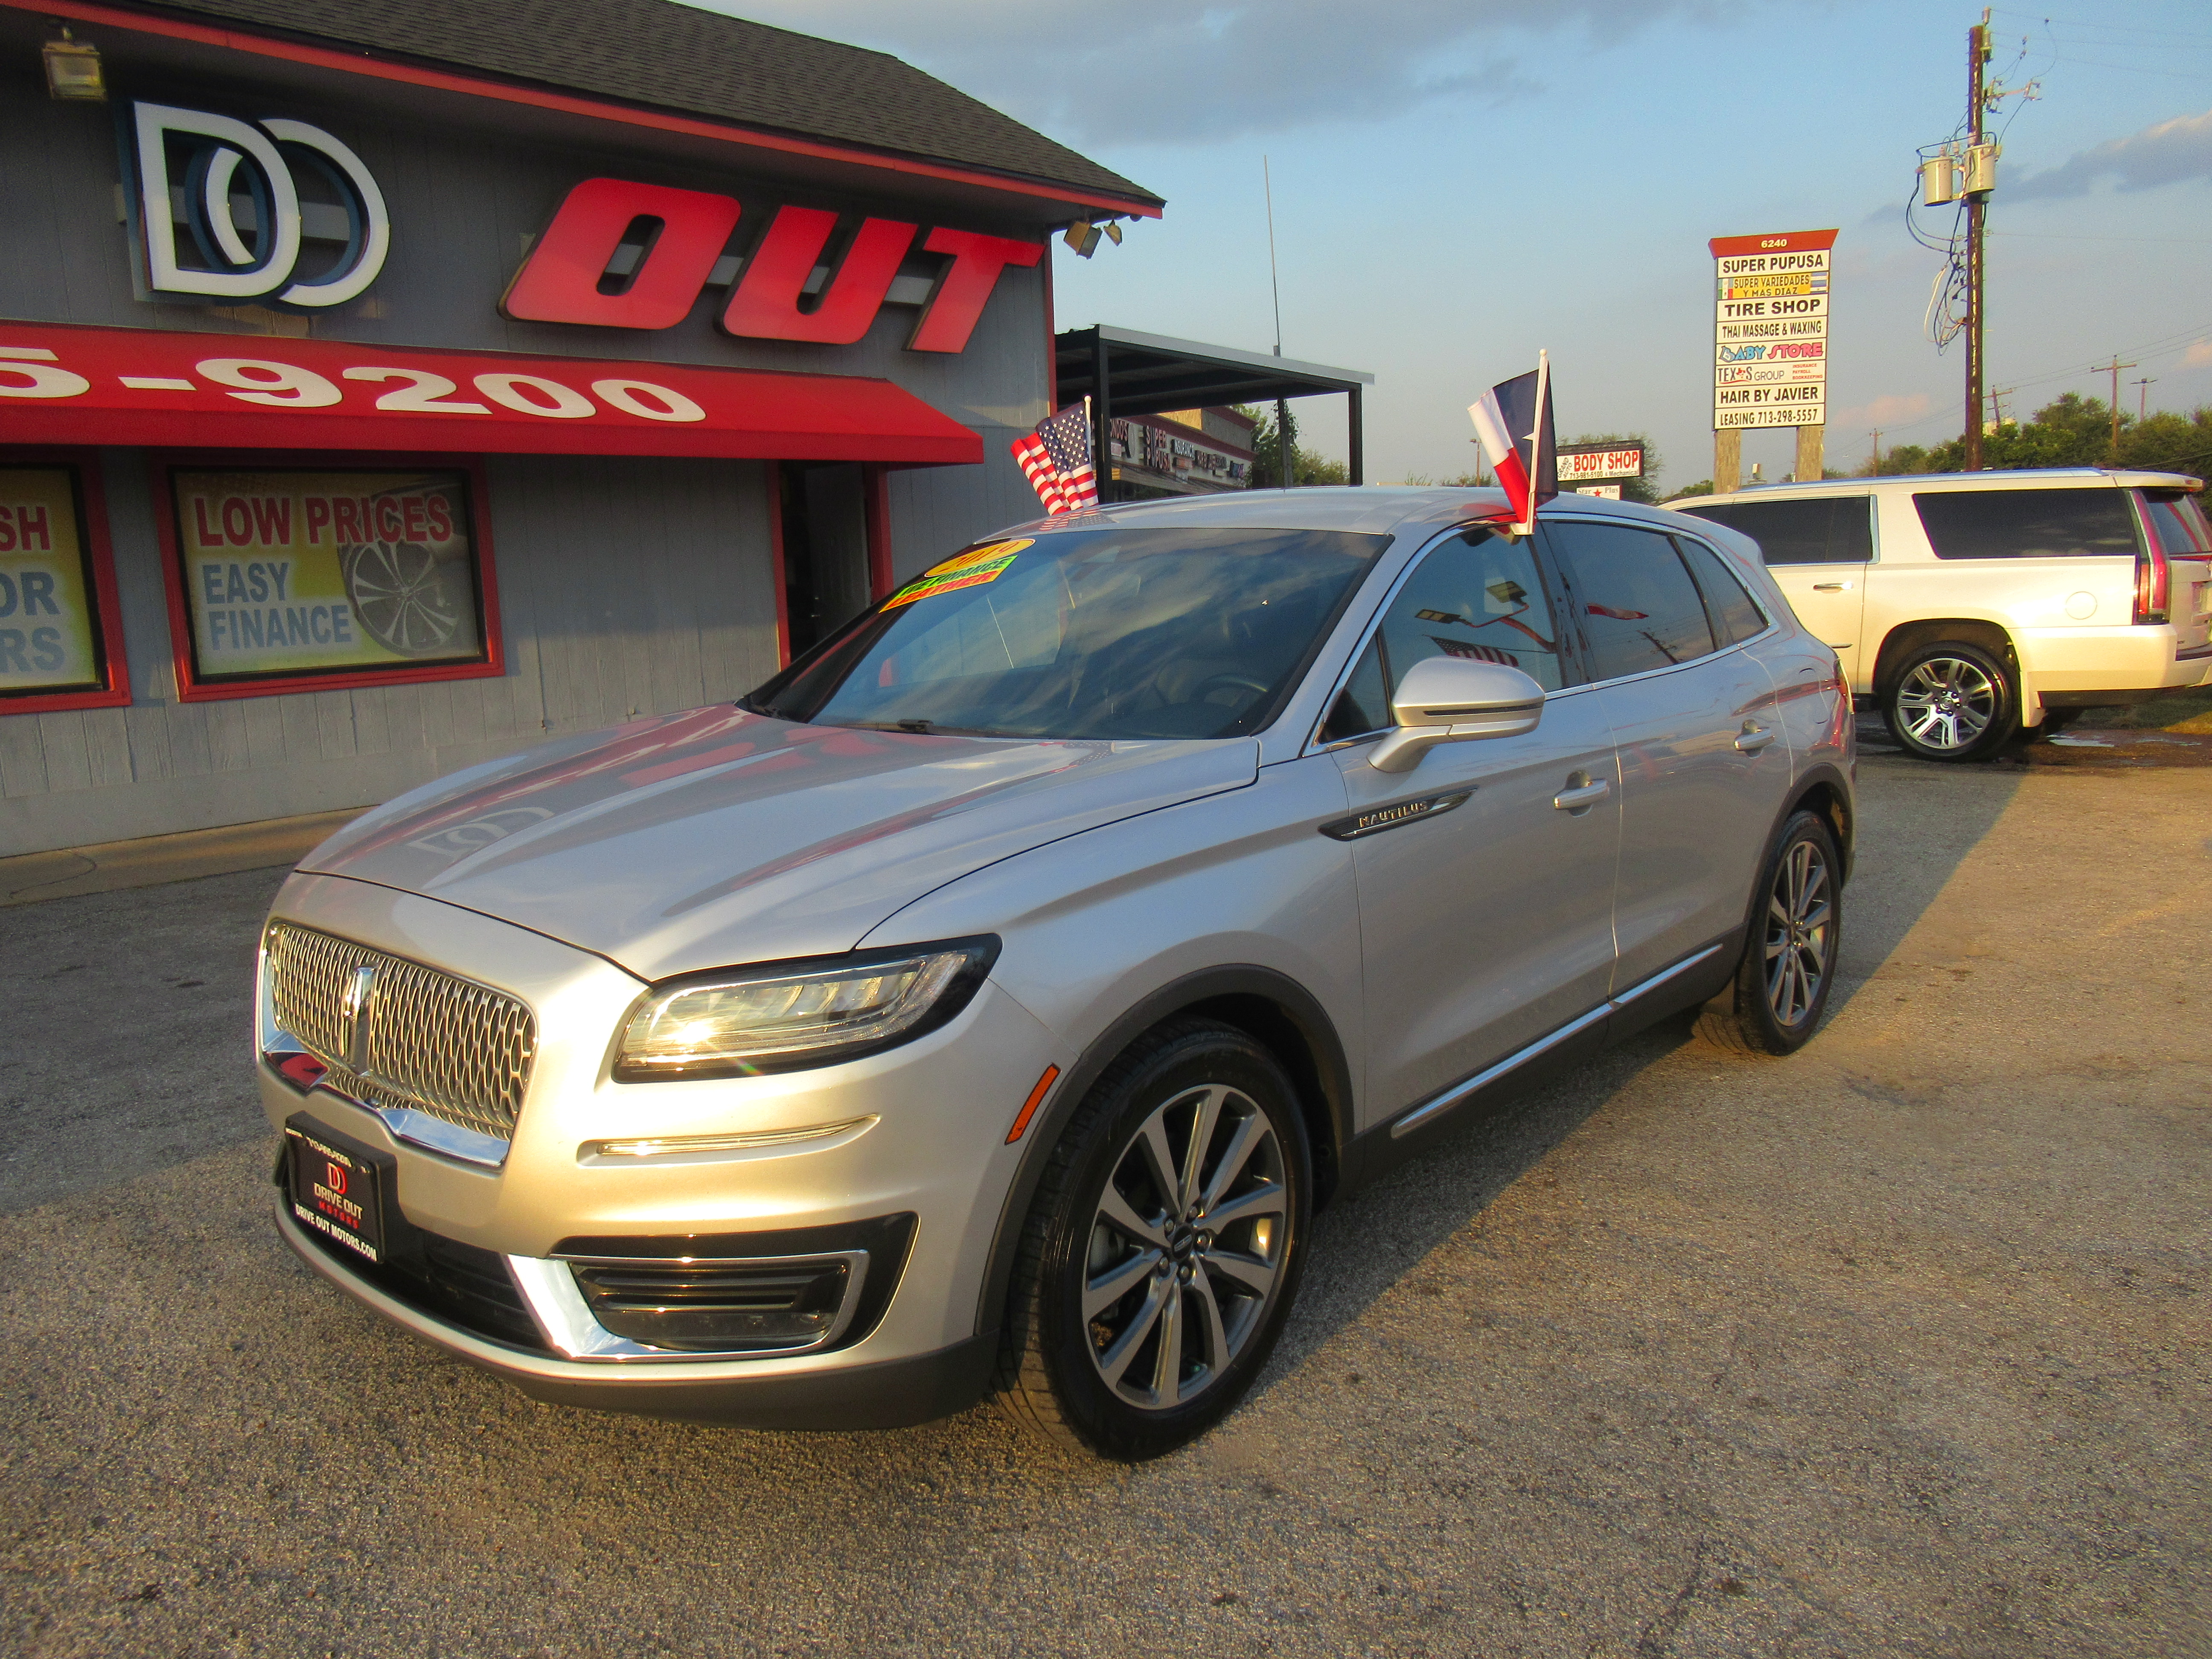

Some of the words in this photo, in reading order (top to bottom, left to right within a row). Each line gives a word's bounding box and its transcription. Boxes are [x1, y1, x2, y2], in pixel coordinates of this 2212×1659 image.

[1761, 239, 1787, 248] 6240
[504, 177, 1046, 353] OUT
[1723, 258, 1766, 274] SUPER
[1770, 254, 1823, 271] PUPUSA
[1734, 278, 1760, 289] SUPER
[1761, 274, 1810, 288] VARIEDADES
[1743, 289, 1749, 297] Y
[1751, 288, 1773, 297] MAS
[1775, 287, 1798, 296] DIAZ
[1724, 302, 1765, 317] TIRE
[1771, 299, 1821, 314] SHOP
[1722, 325, 1740, 339] THAI
[1742, 323, 1780, 338] MASSAGE
[1782, 323, 1787, 335] &
[1790, 320, 1822, 335] WAXING
[1719, 345, 1766, 363] BABY
[1767, 342, 1824, 359] STORE
[1754, 370, 1784, 381] GROUP
[1720, 389, 1750, 404] HAIR
[1754, 389, 1770, 402] BY
[1774, 387, 1818, 401] JAVIER
[1720, 412, 1755, 426] LEASING
[1758, 408, 1818, 424] 713-298-5557
[1146, 425, 1166, 448] SUPER
[1147, 447, 1171, 471] PUPUSA
[1557, 457, 1569, 478] GRAND
[1574, 453, 1604, 472] BODY
[1608, 451, 1638, 470] SHOP
[194, 497, 291, 547] LOW
[305, 495, 453, 544] PRICES
[928, 558, 1012, 585] FINANCE
[203, 562, 289, 604] EASY
[885, 570, 998, 609] LEATHER
[208, 605, 352, 651] FINANCE
[1359, 801, 1428, 828] NAUTILUS
[314, 1182, 343, 1209] DRIVE
[343, 1198, 364, 1220] OUT
[295, 1203, 316, 1225] DRIVE
[316, 1216, 330, 1232] OUT
[319, 1200, 359, 1229] MOTORS
